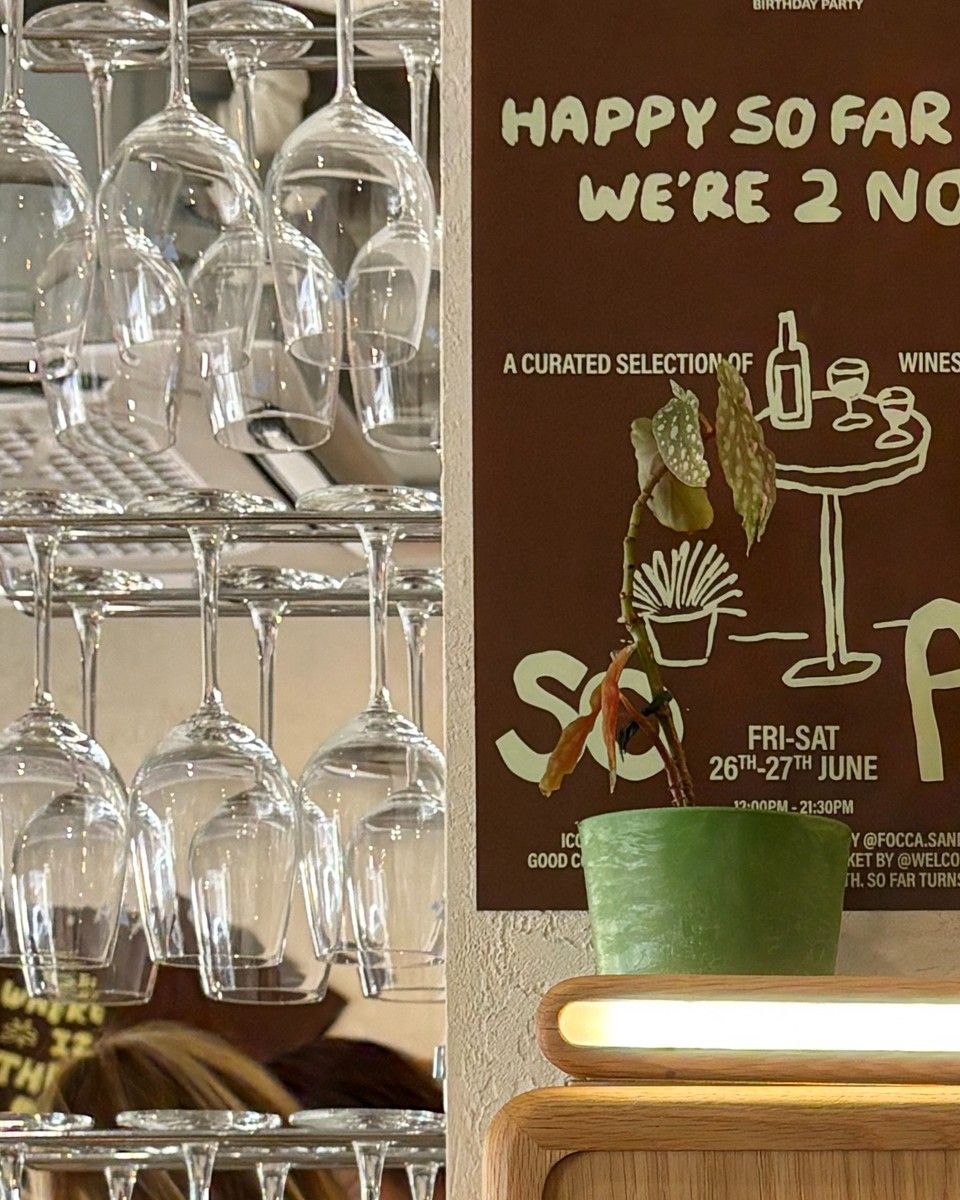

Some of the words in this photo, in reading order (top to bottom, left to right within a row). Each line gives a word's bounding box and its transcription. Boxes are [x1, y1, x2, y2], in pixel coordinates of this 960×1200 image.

[753, 0, 818, 11] BIRTHDAY
[821, 0, 864, 11] PARTY
[502, 95, 716, 149] HAPPY
[730, 95, 816, 149] SO
[831, 91, 952, 149] FAR
[579, 170, 770, 223] WE'RE
[794, 168, 842, 224] 2
[503, 353, 517, 374] A
[522, 353, 611, 374] CURATED
[616, 353, 722, 374] SELECTION
[728, 353, 753, 374] OF
[748, 725, 840, 751] FRI-SAT
[817, 755, 878, 781] JUNE
[800, 800, 854, 814] 21:30PM
[527, 853, 568, 869] GOOD
[876, 852, 894, 868] BY
[867, 872, 886, 888] SO
[889, 872, 916, 888] FAR
